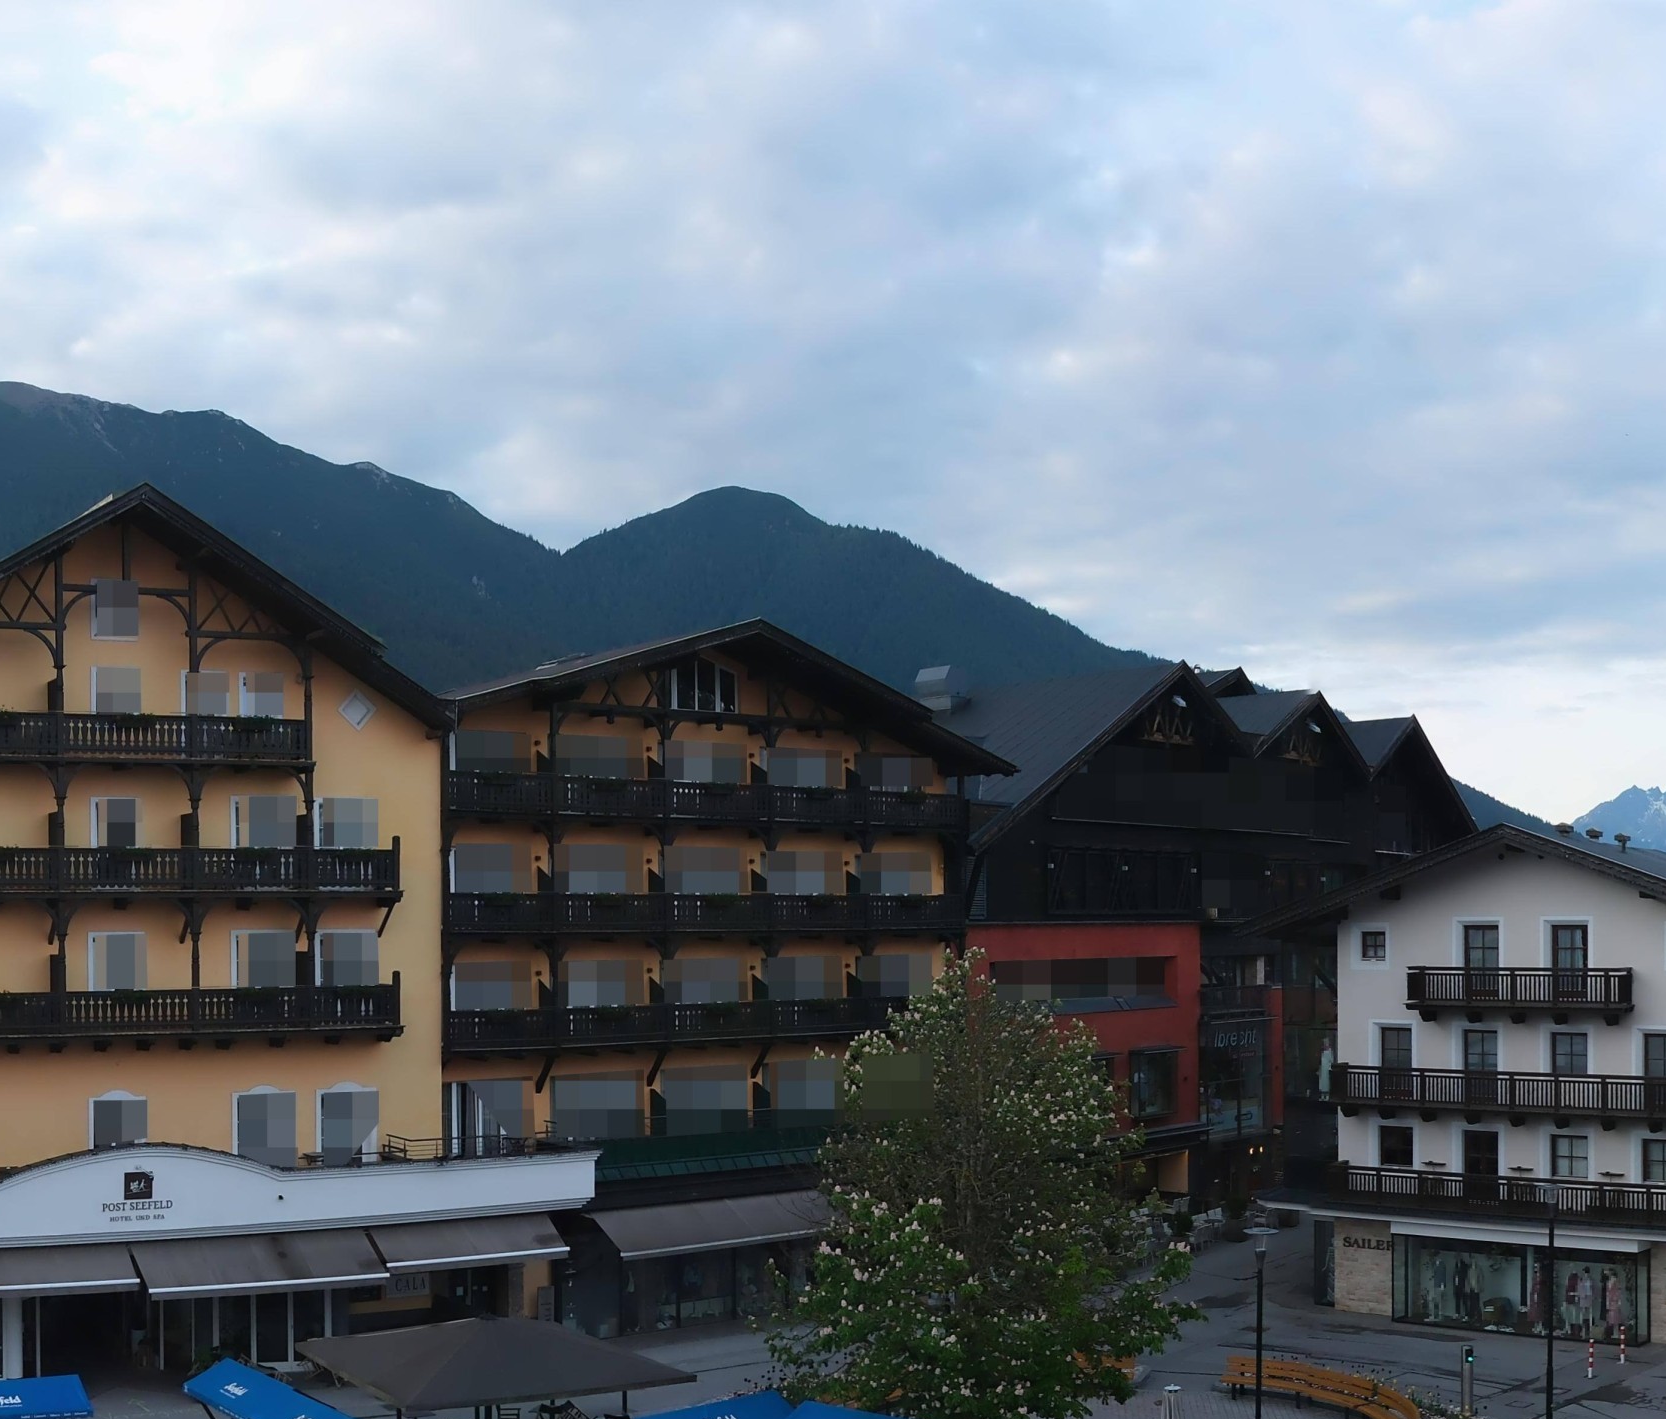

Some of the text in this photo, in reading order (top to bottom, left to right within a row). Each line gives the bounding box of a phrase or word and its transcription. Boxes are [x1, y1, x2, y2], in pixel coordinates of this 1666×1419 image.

[102, 1200, 173, 1213] POST SEEFELD
[395, 1276, 426, 1292] CALA
